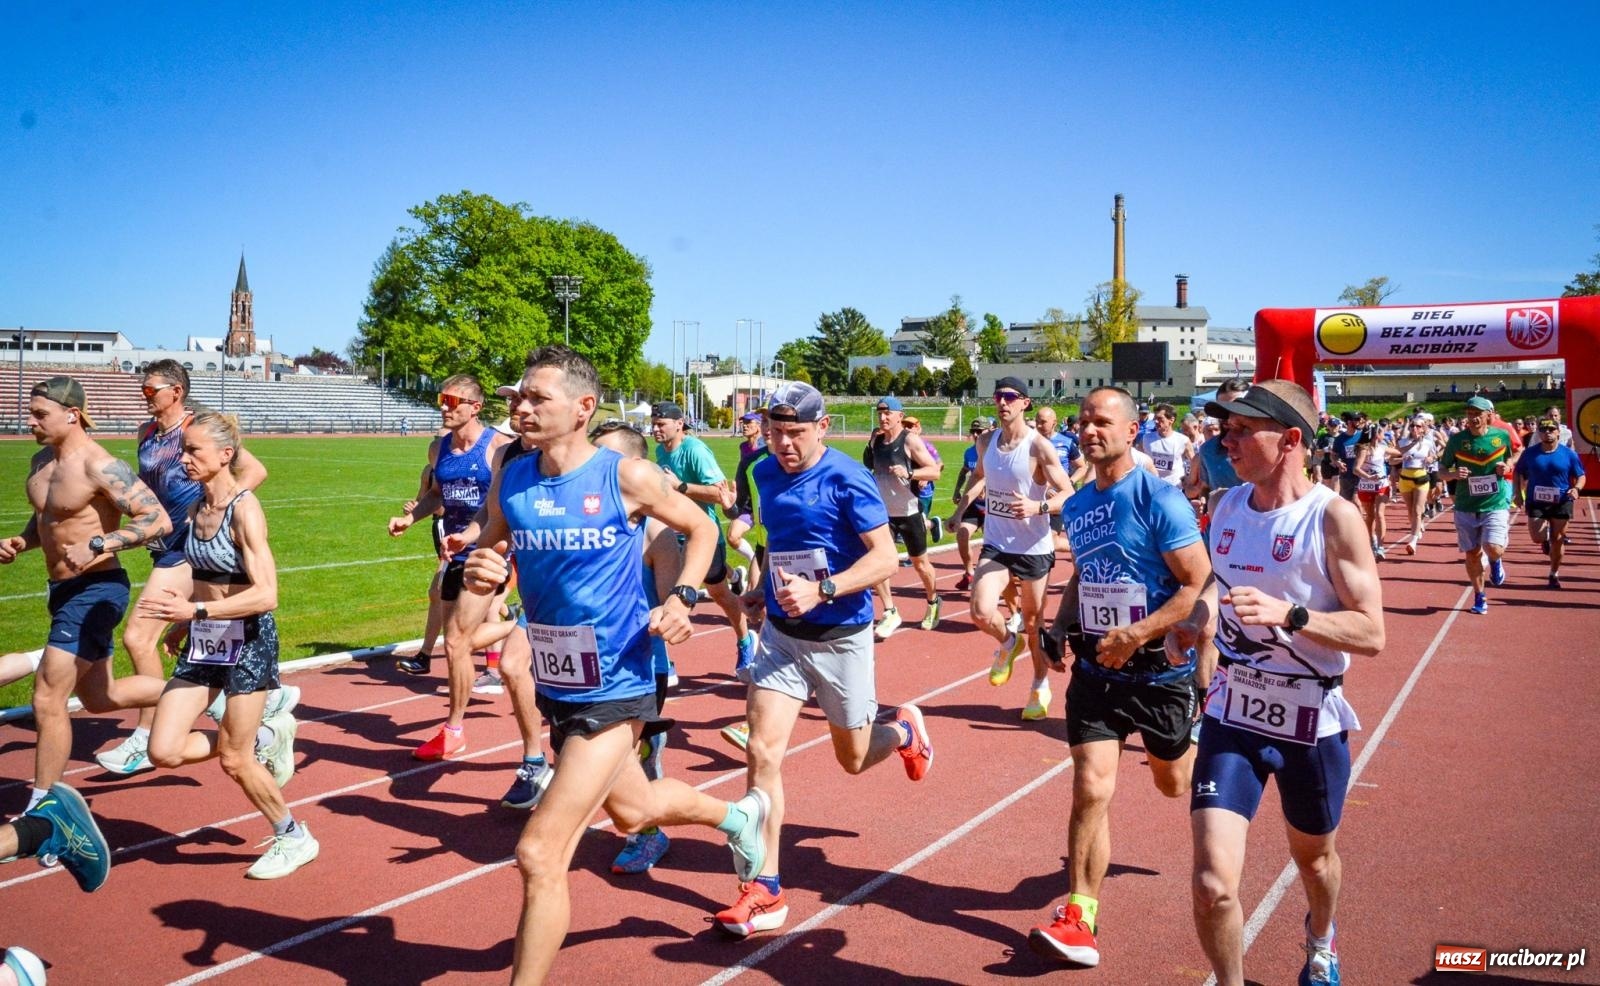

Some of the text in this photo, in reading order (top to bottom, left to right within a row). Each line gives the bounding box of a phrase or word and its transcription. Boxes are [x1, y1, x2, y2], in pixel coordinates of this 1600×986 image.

[1412, 310, 1455, 320] BIEG
[1380, 324, 1487, 338] BEZ GRANIC
[1388, 340, 1478, 355] RACIBÓRZ
[1473, 484, 1489, 492] 190
[1070, 521, 1117, 550] ACIBÓRZ
[1092, 605, 1119, 626] 131
[198, 638, 227, 656] 164
[540, 651, 576, 677] 184
[1264, 676, 1275, 686] BEZ
[1276, 679, 1302, 690] GRANIC
[1241, 693, 1286, 727] 128
